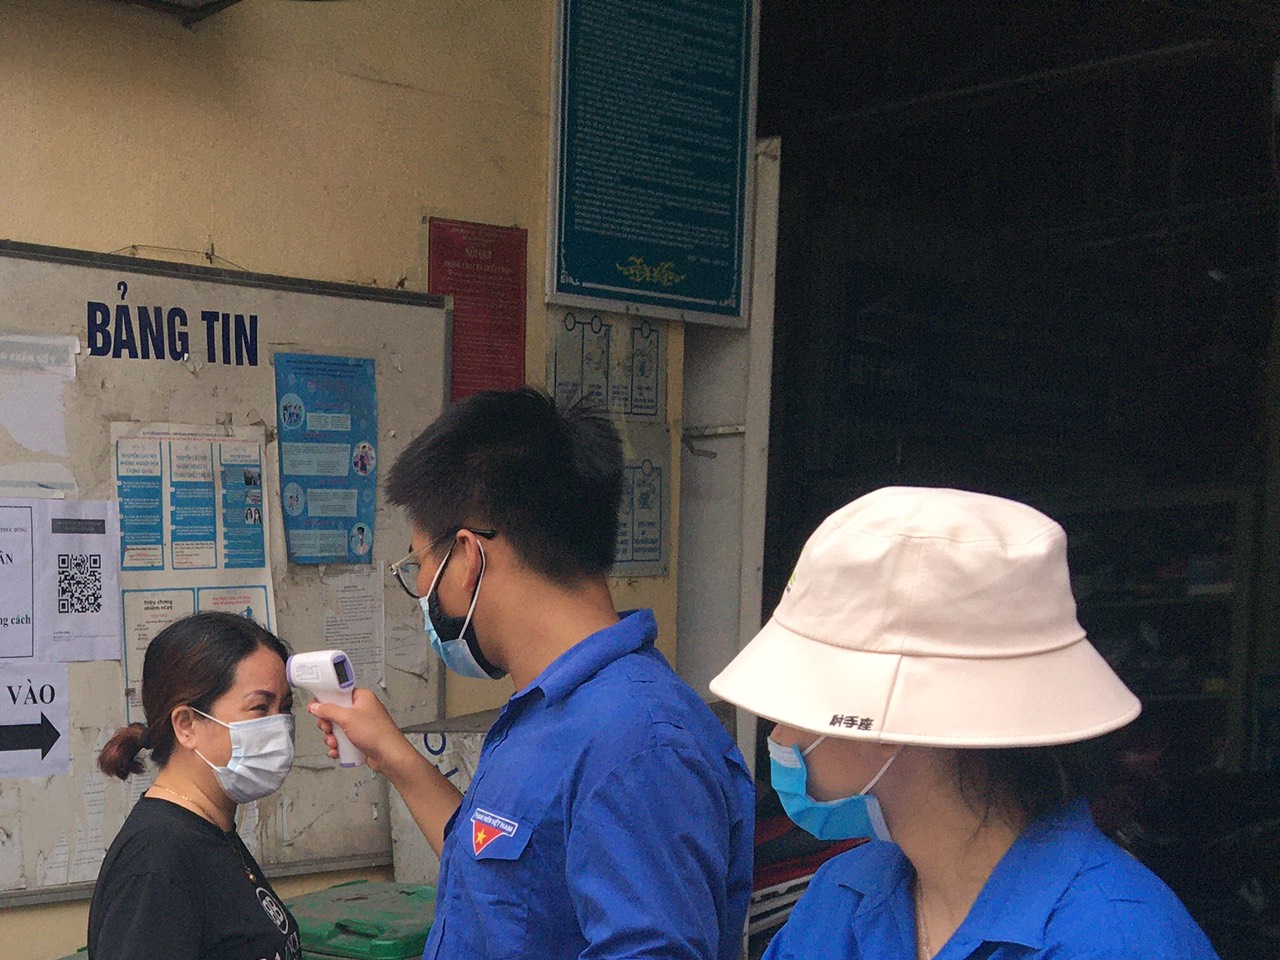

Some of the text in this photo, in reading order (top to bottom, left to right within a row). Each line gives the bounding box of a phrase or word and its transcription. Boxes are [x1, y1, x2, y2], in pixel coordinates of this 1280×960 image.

[87, 281, 258, 366] BẢNG TIN
[11, 614, 31, 625] cách
[7, 679, 56, 705] VÀO
